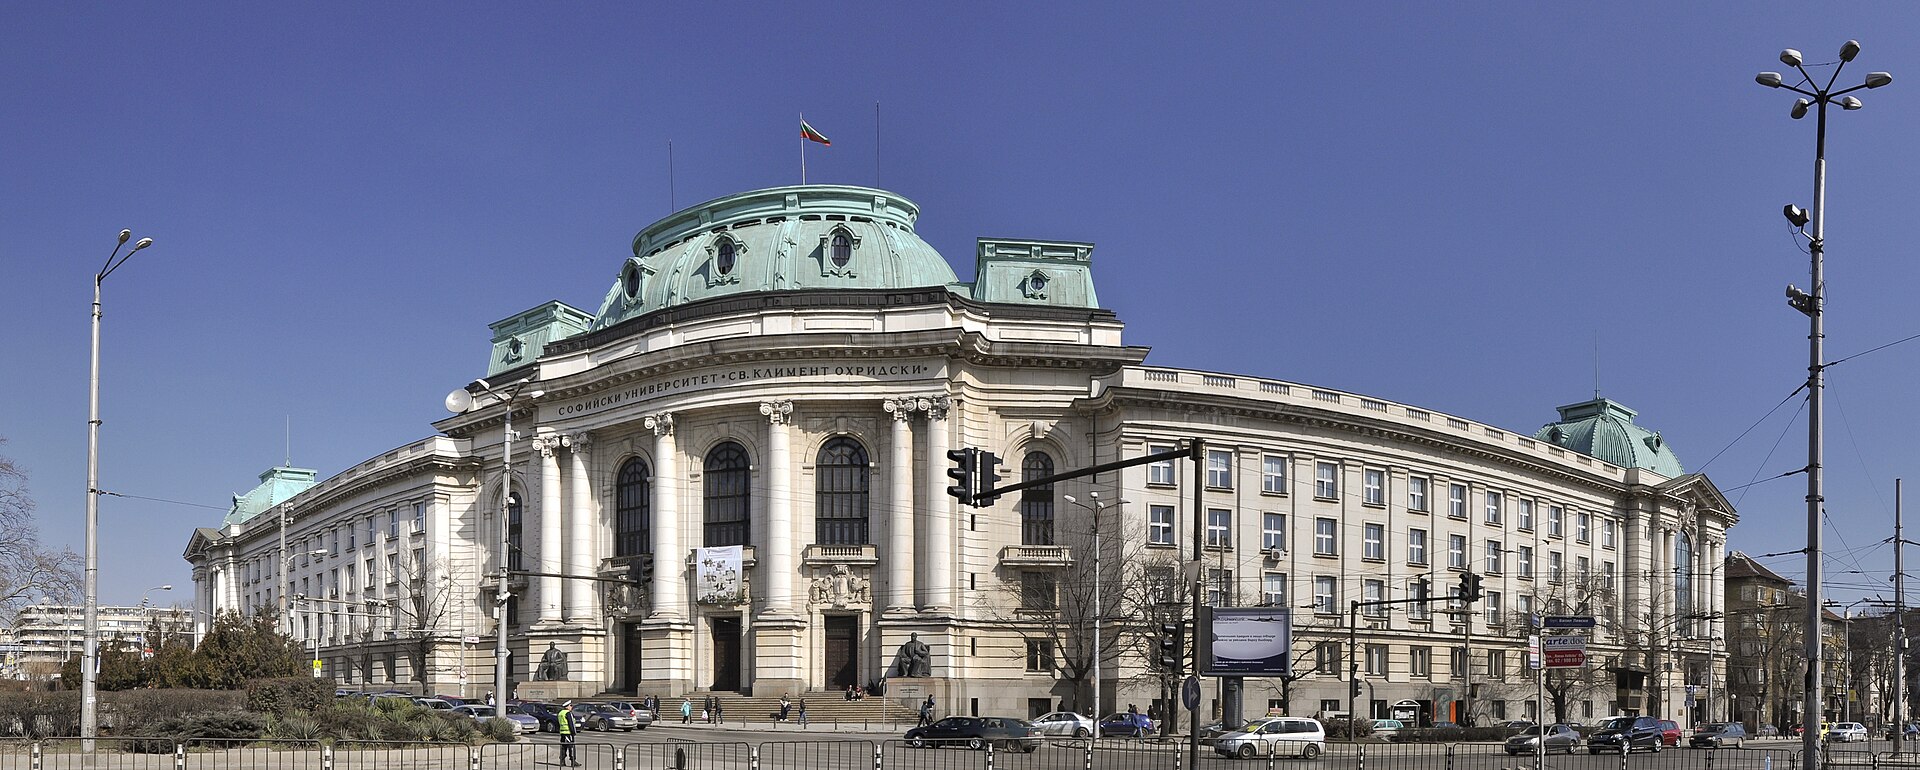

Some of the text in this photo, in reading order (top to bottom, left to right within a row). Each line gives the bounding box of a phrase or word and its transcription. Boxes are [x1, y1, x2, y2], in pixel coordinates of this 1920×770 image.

[558, 393, 621, 416] СОФИЙСКИ
[625, 373, 718, 399] УНИВЕРСИТЕТ
[753, 366, 829, 378] КЛИМЕНТ
[835, 365, 921, 376] ОХРИДСКИ
[1546, 637, 1568, 645] arte
